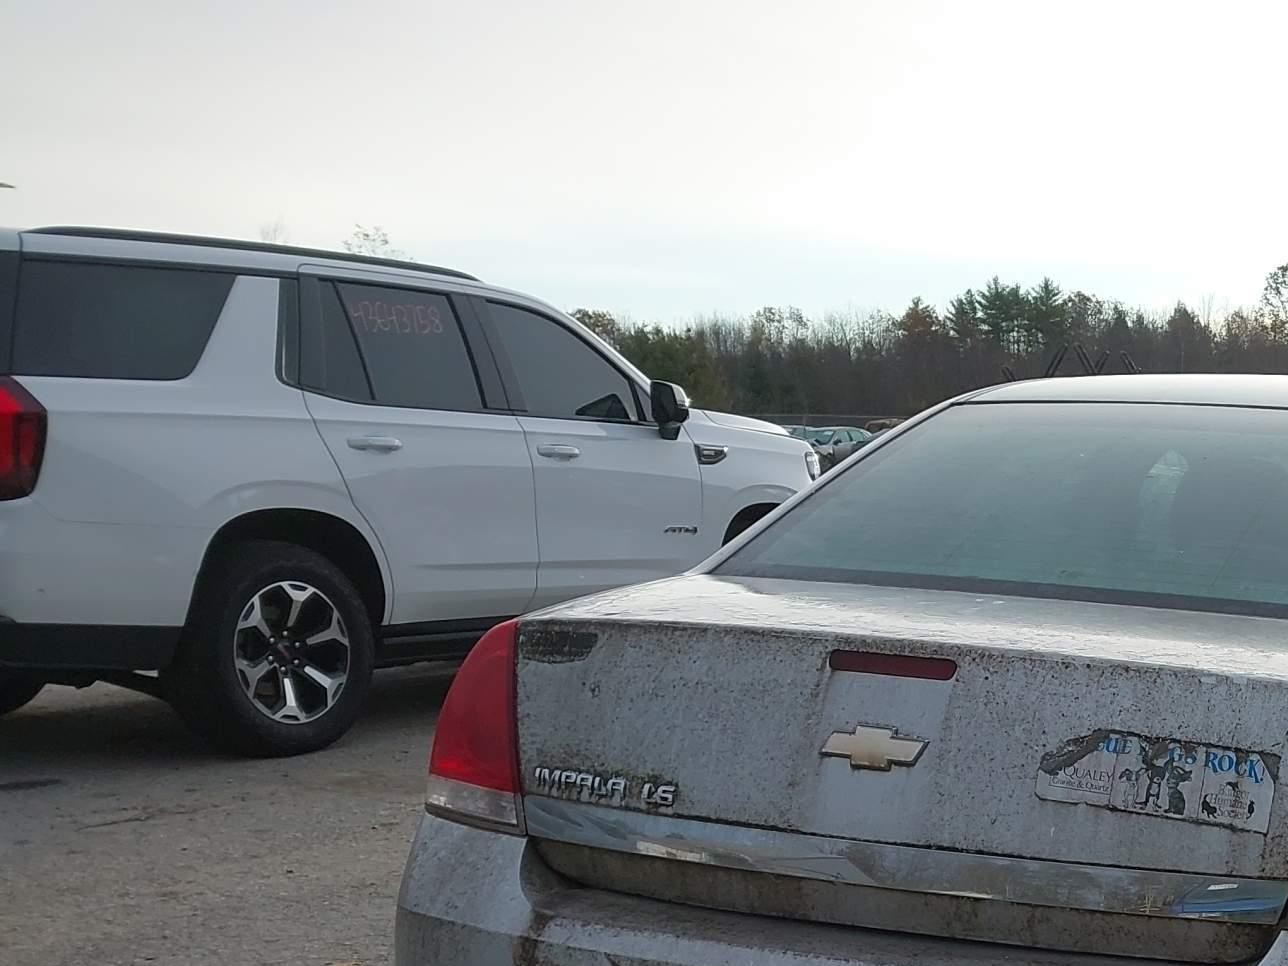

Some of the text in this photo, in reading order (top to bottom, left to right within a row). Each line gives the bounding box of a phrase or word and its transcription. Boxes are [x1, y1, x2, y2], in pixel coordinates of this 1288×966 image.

[534, 767, 677, 806] IMPALA LS
[1063, 765, 1114, 783] QUALEY
